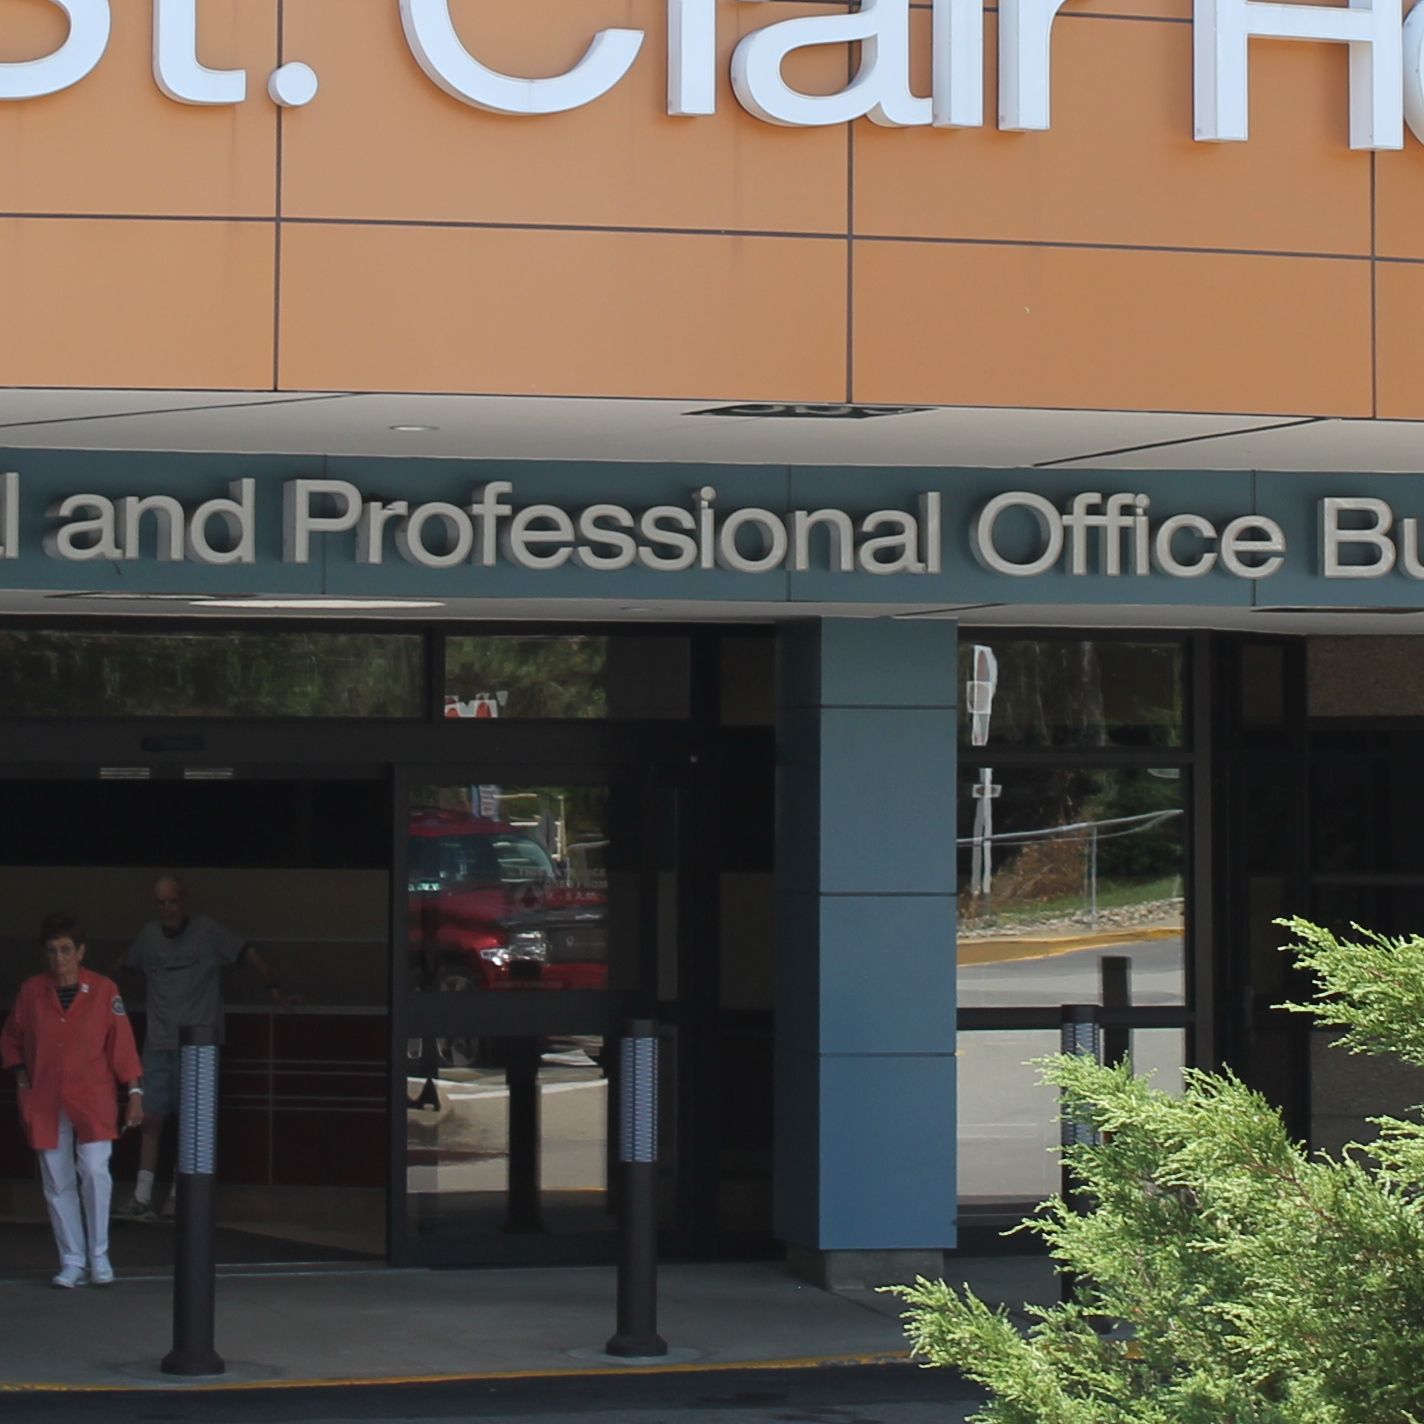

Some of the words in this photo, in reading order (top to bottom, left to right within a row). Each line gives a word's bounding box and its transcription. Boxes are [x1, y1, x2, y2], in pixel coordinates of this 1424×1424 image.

[41, 477, 256, 564] and
[283, 478, 942, 576] Professional
[969, 490, 1287, 579] Office
